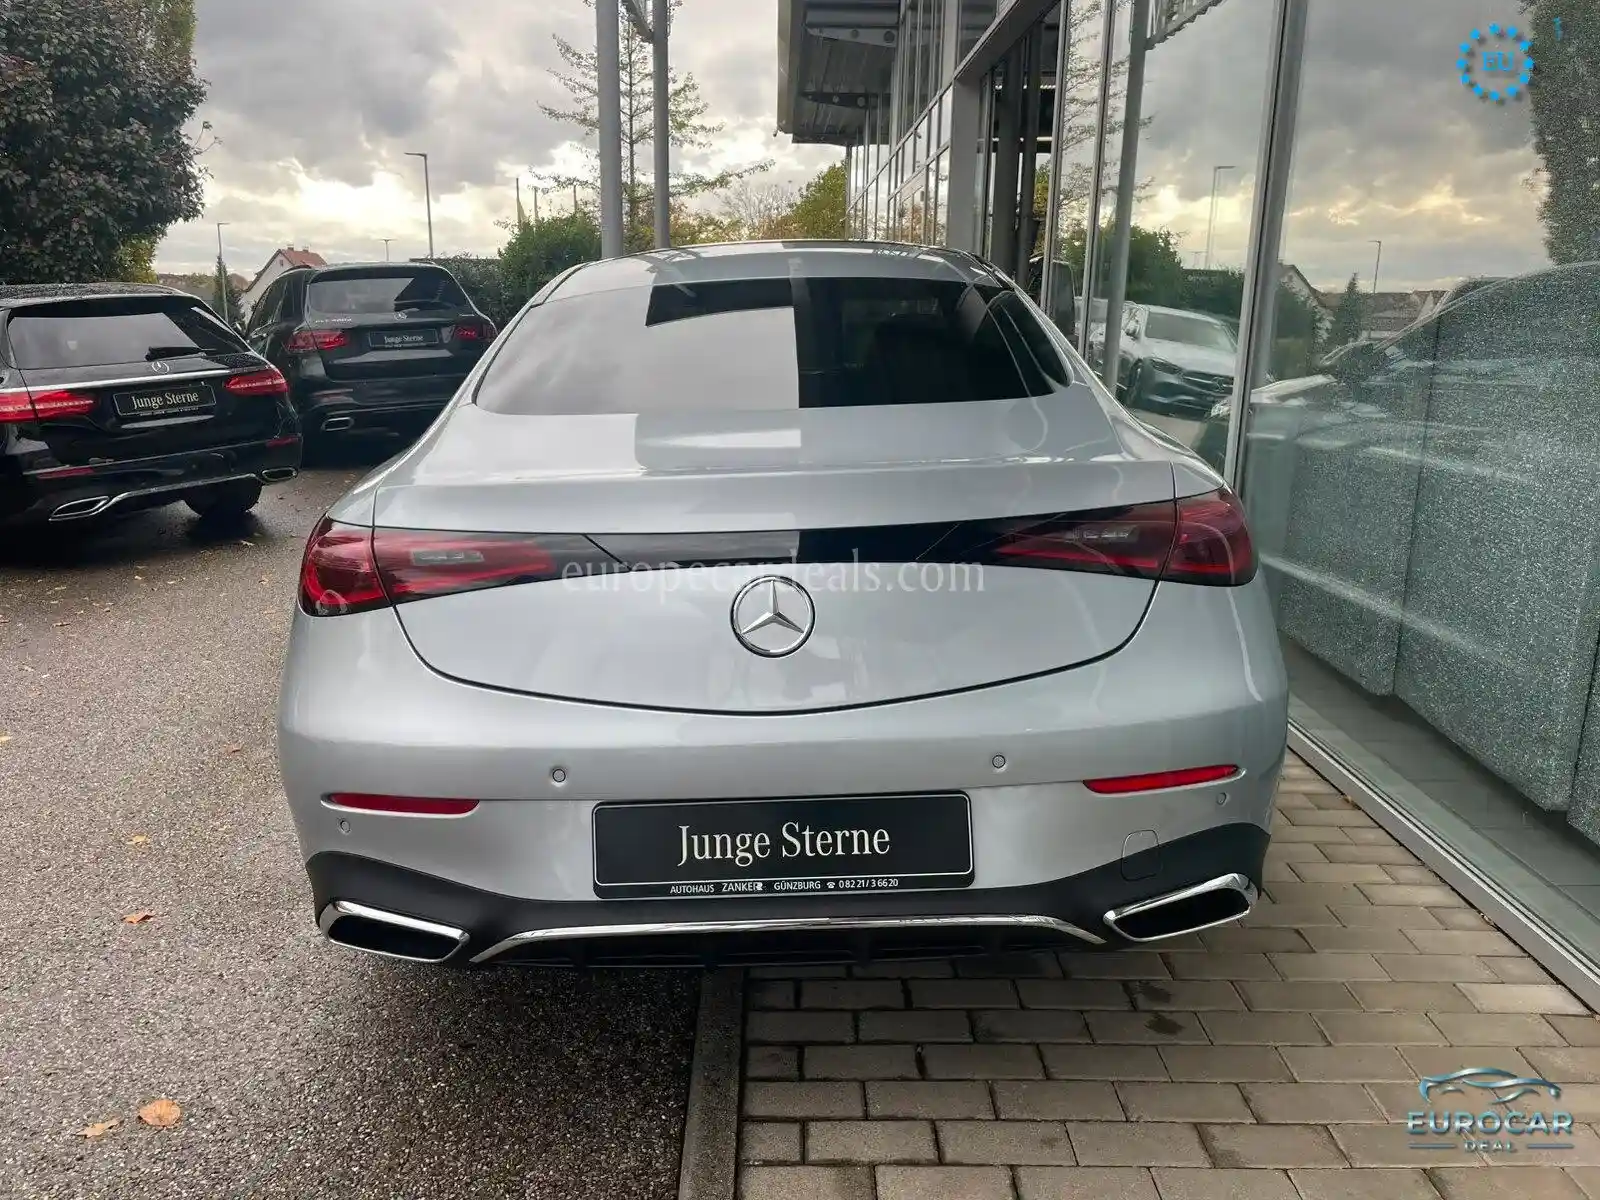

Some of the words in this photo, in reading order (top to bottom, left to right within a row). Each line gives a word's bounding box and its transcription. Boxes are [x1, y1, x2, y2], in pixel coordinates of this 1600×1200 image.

[131, 396, 164, 410] Junge
[164, 392, 200, 405] Sterne
[677, 825, 771, 867] Junge
[781, 821, 891, 858] Sterne
[669, 884, 715, 894] AUTOHAUS
[721, 881, 763, 892] ZANKER
[773, 880, 821, 891] GÜNZBURG
